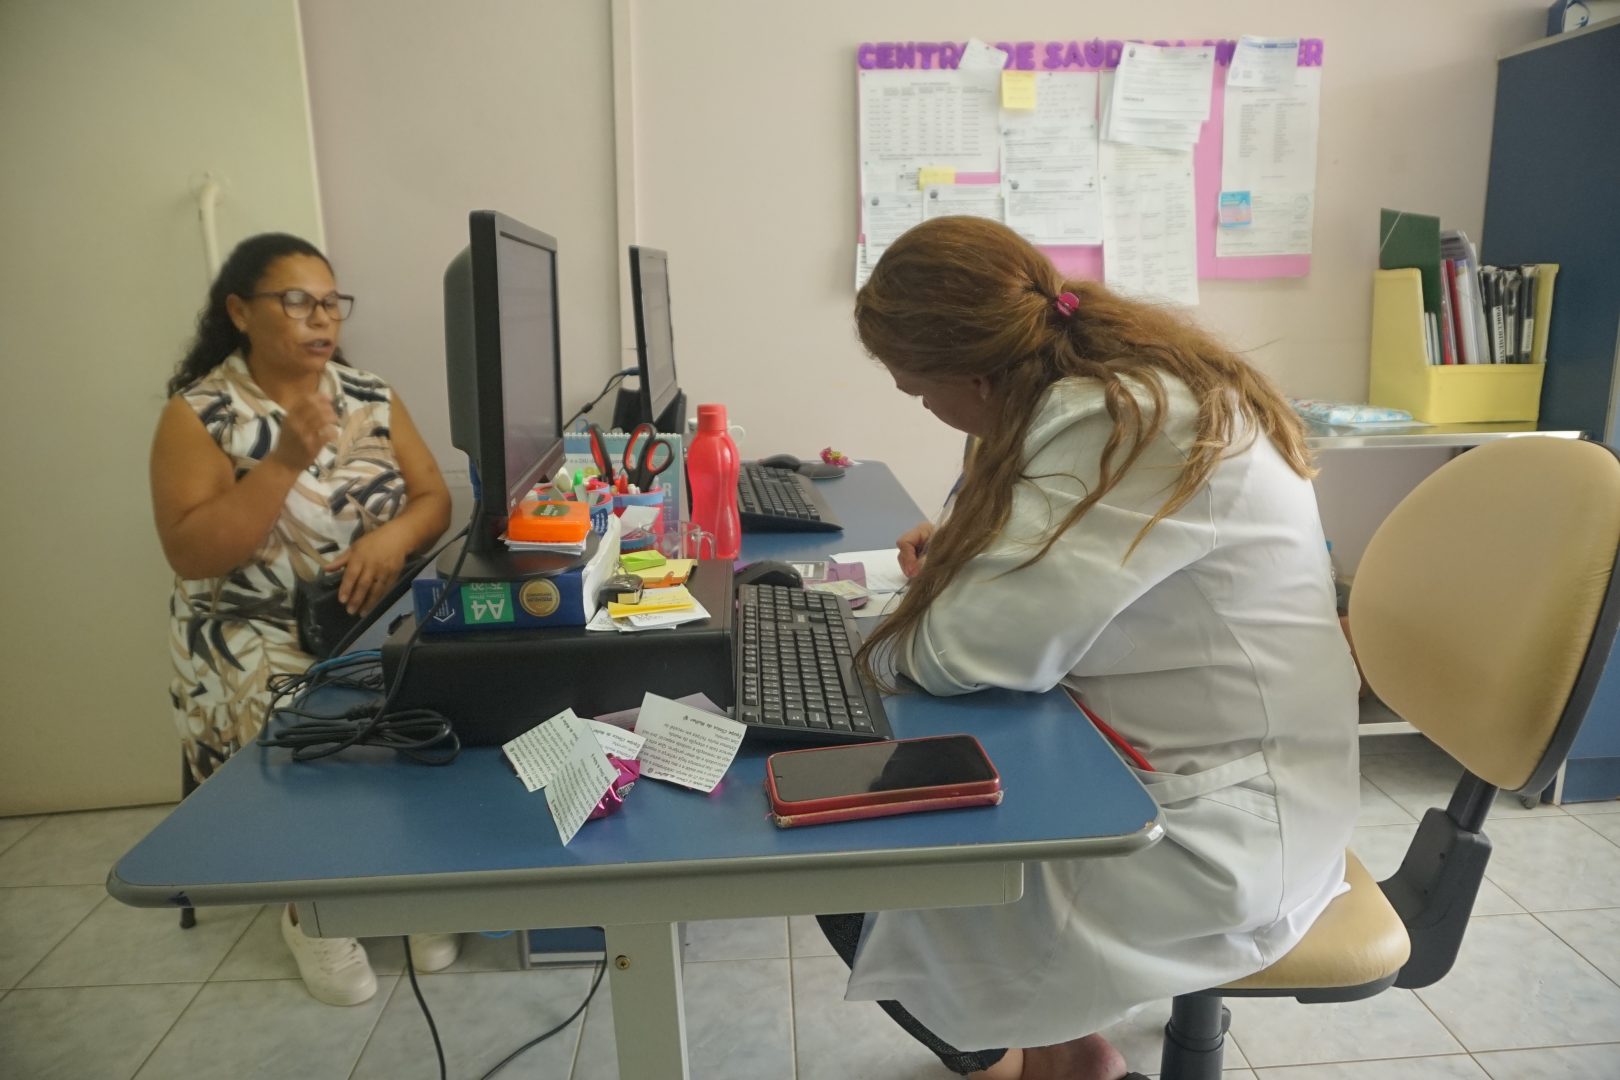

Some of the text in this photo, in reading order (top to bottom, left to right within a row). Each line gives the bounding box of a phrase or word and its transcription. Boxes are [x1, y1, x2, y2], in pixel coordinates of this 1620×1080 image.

[857, 41, 969, 70] CENTR
[1042, 38, 1144, 69] SAÚD
[470, 598, 504, 620] A4
